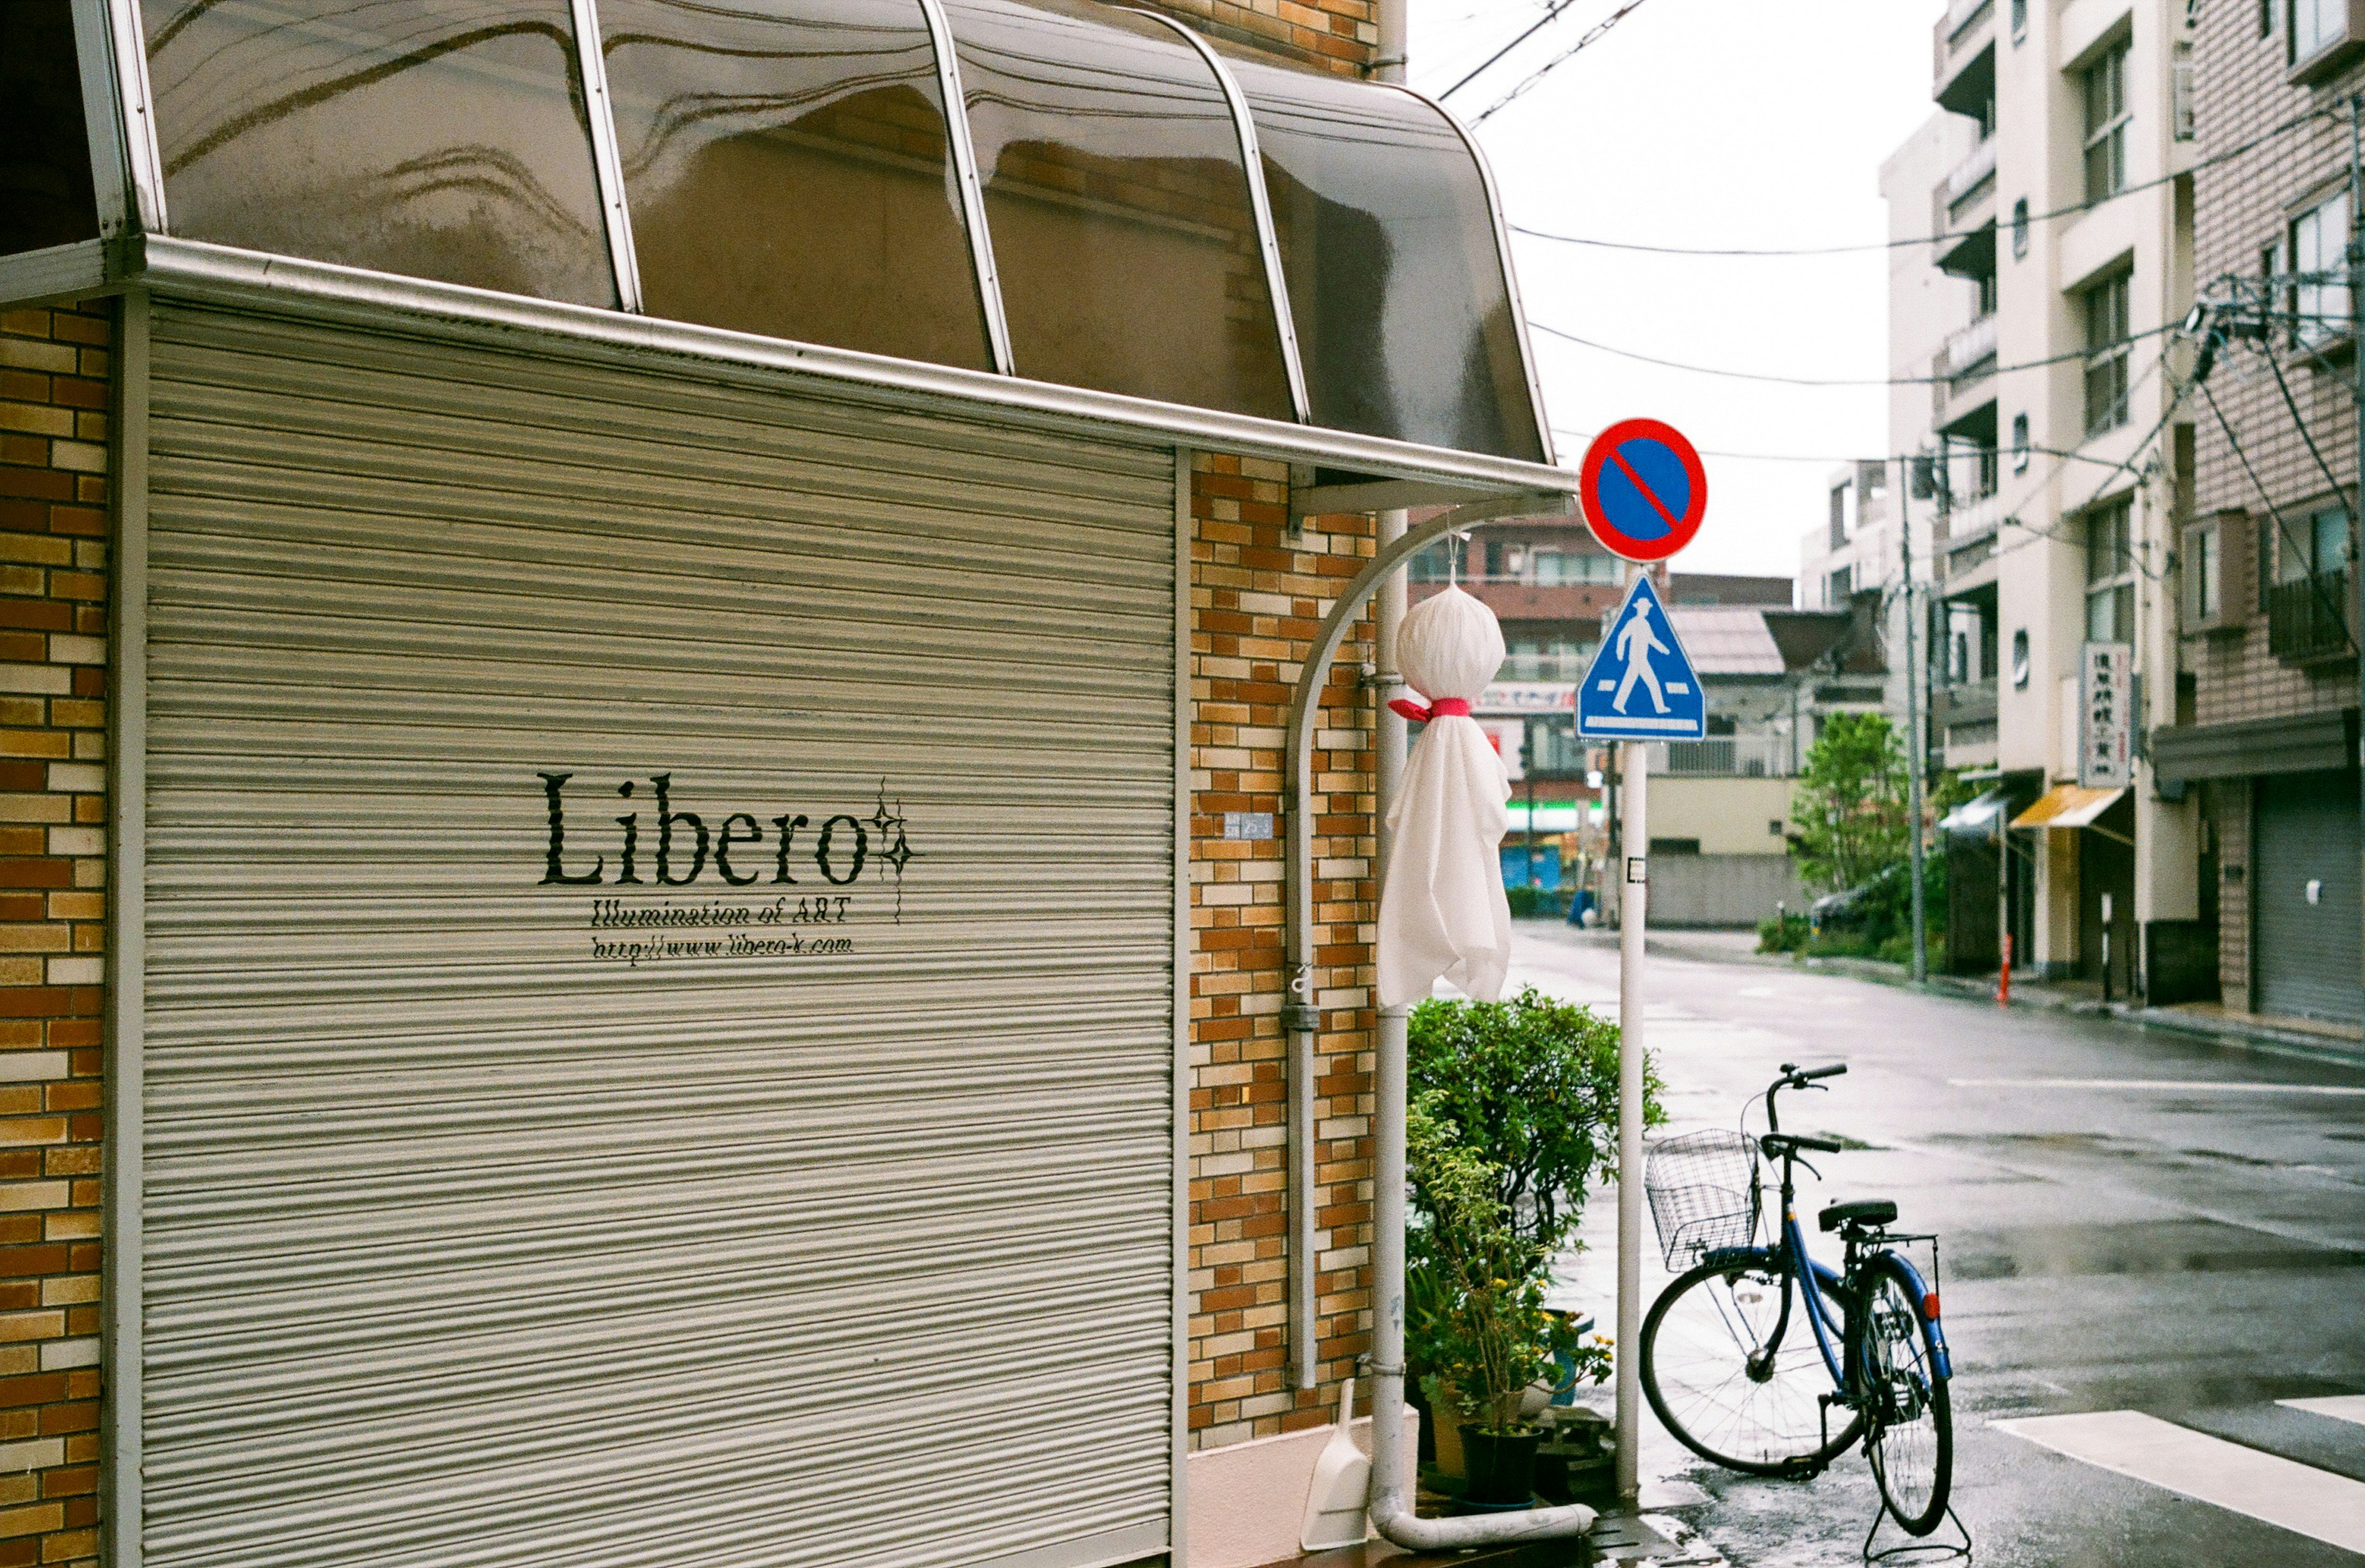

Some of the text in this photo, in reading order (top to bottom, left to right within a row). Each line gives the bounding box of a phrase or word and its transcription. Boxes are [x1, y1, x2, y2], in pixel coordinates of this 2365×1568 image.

[537, 772, 867, 885] Libero
[591, 897, 851, 927] Illumination of ART
[591, 932, 854, 967] http://www.libero-k.com
